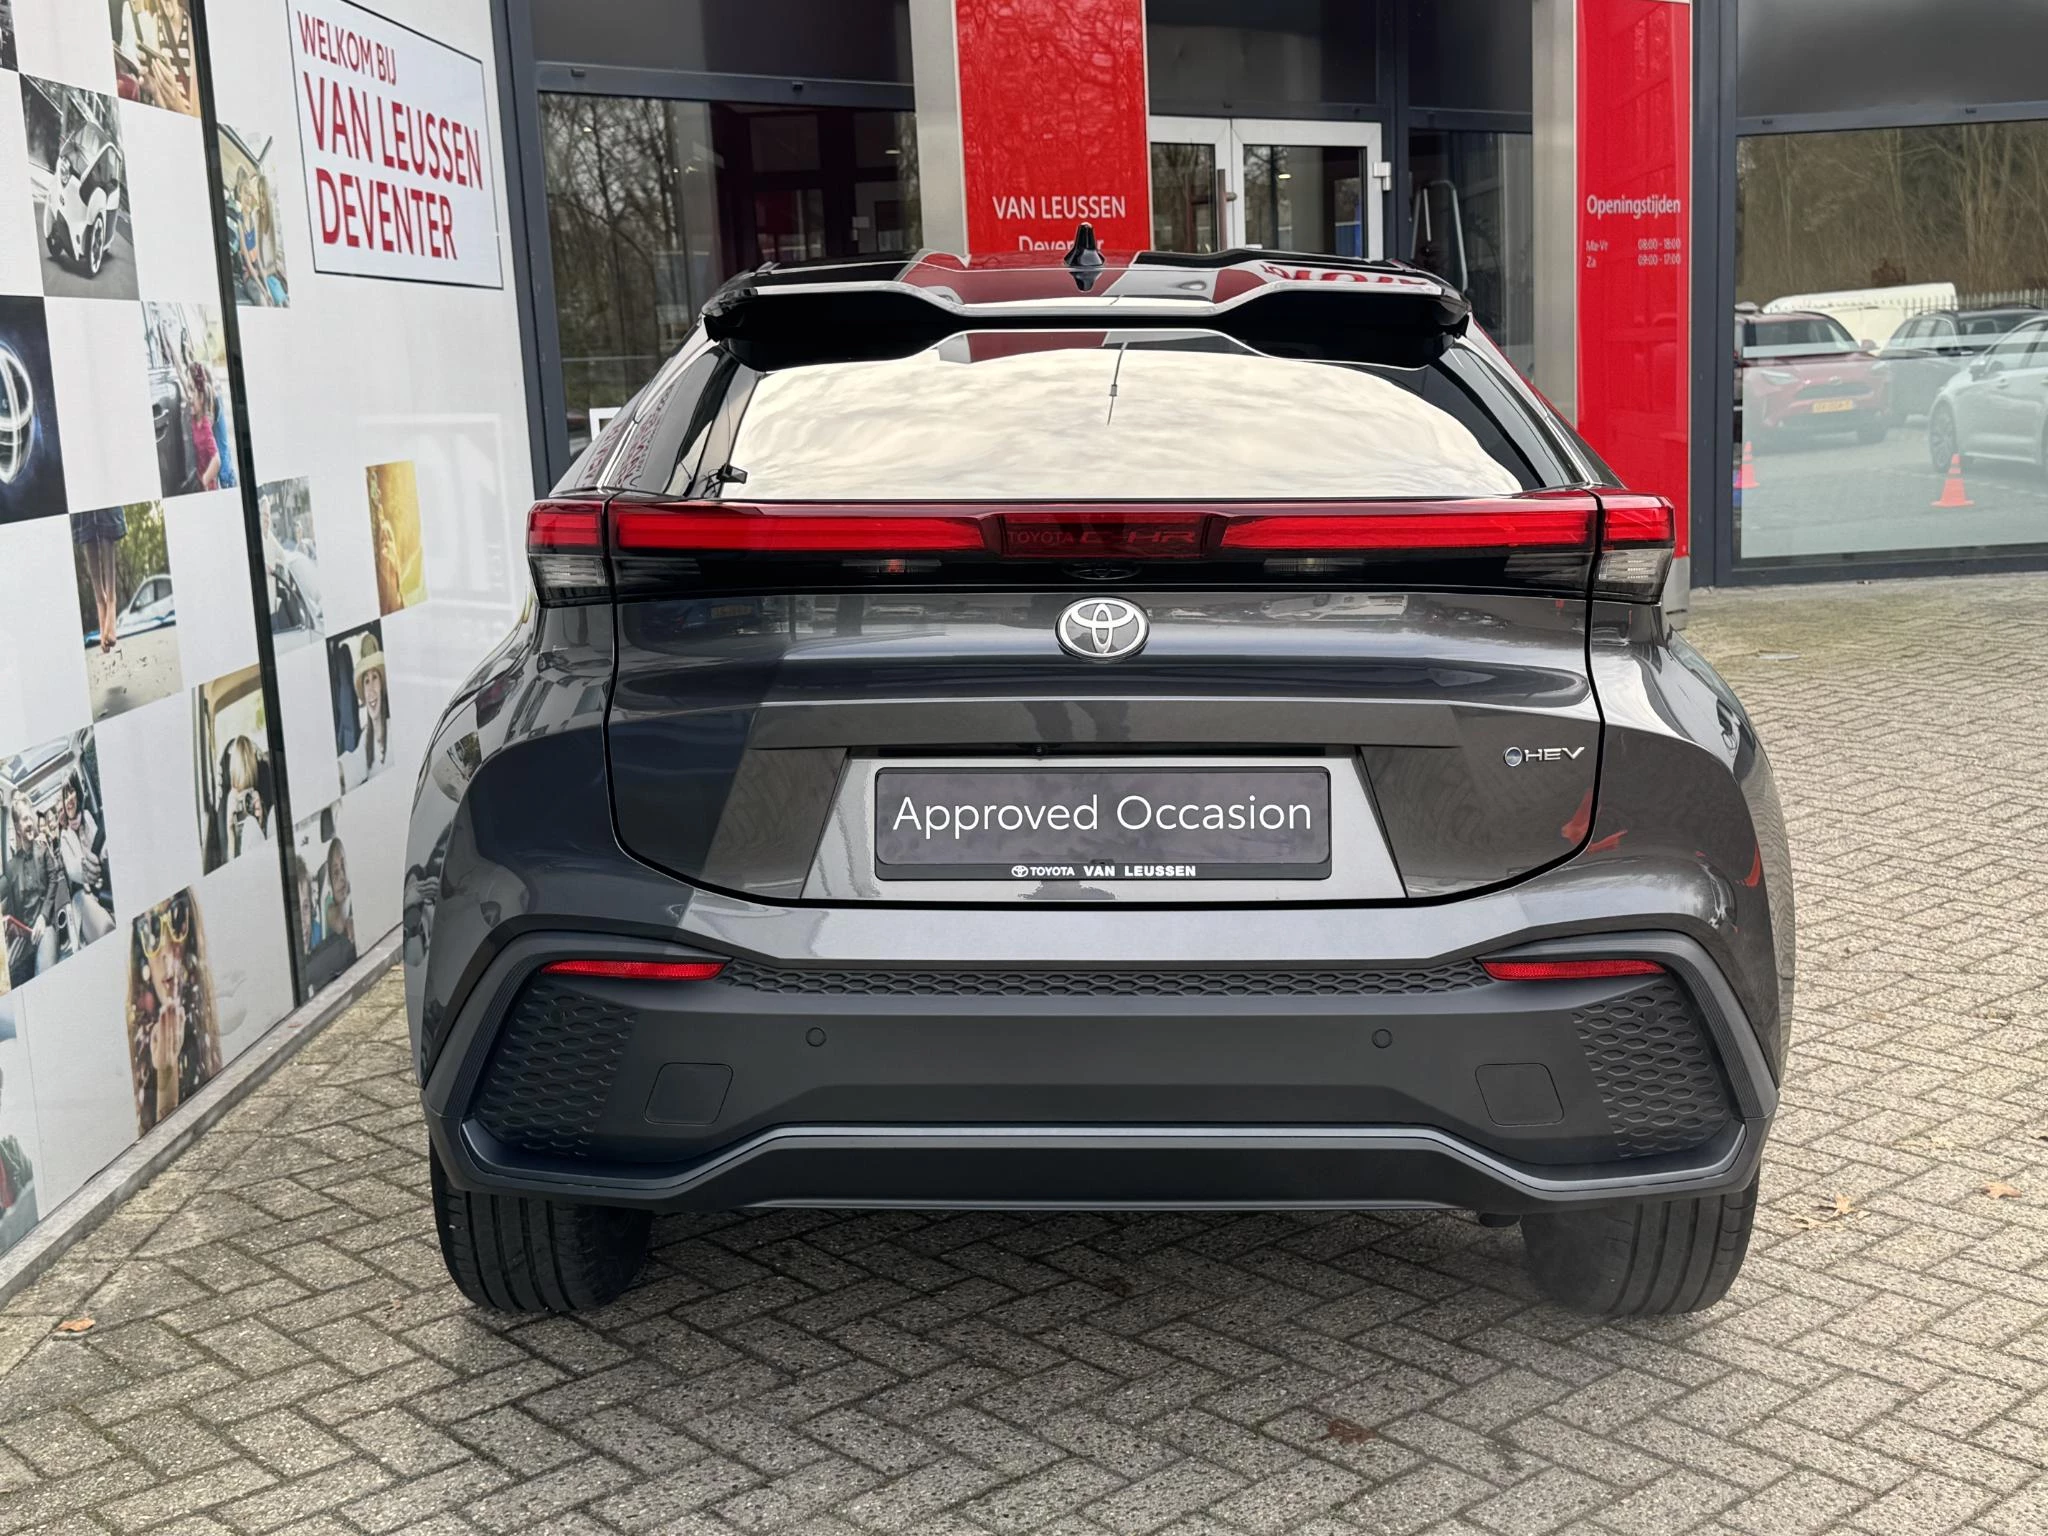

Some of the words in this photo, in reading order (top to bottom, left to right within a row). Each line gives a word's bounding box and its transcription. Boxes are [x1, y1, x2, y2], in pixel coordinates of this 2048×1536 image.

[297, 10, 375, 78] WELKOM
[375, 42, 397, 86] BIJ
[303, 71, 374, 163] VAN
[377, 96, 483, 190] LEUSSEN
[316, 167, 458, 260] DEVENTER
[992, 195, 1036, 220] VAN
[1041, 195, 1126, 219] LEUSSEN
[1586, 194, 1681, 220] Openingstijden
[1008, 531, 1075, 545] TOYOTA
[1524, 746, 1585, 762] HEV
[892, 794, 1098, 839] Approved
[1117, 795, 1311, 830] Occasion
[1030, 866, 1075, 877] TOYOTA
[1083, 865, 1116, 877] VAN
[1124, 865, 1196, 877] LEUSSEN
